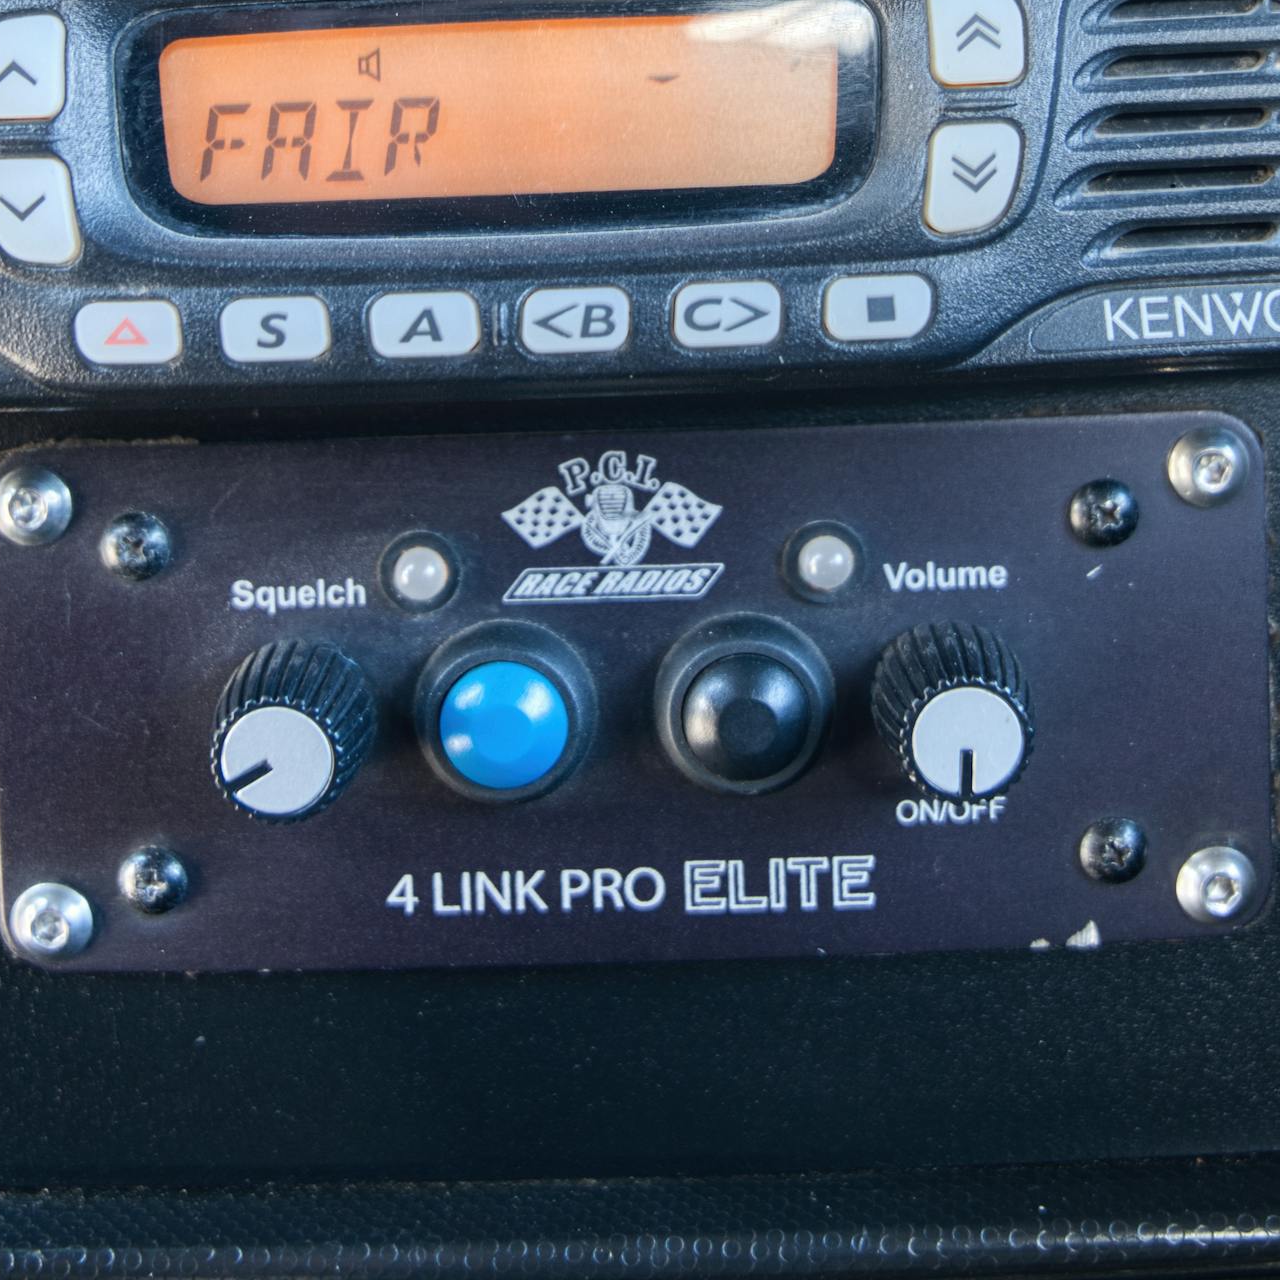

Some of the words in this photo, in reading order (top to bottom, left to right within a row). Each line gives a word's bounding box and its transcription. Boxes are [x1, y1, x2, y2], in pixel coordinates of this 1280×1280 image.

[200, 96, 442, 182] FAIR
[256, 313, 288, 348] S
[399, 308, 443, 343] A
[513, 571, 599, 597] RACE
[593, 568, 712, 595] RADIOS
[882, 560, 1008, 592] Volume
[231, 579, 366, 614] Squelch
[386, 874, 419, 914] 4
[432, 870, 549, 914] LINK
[561, 866, 666, 912] PRO
[684, 854, 877, 915] ELITE
